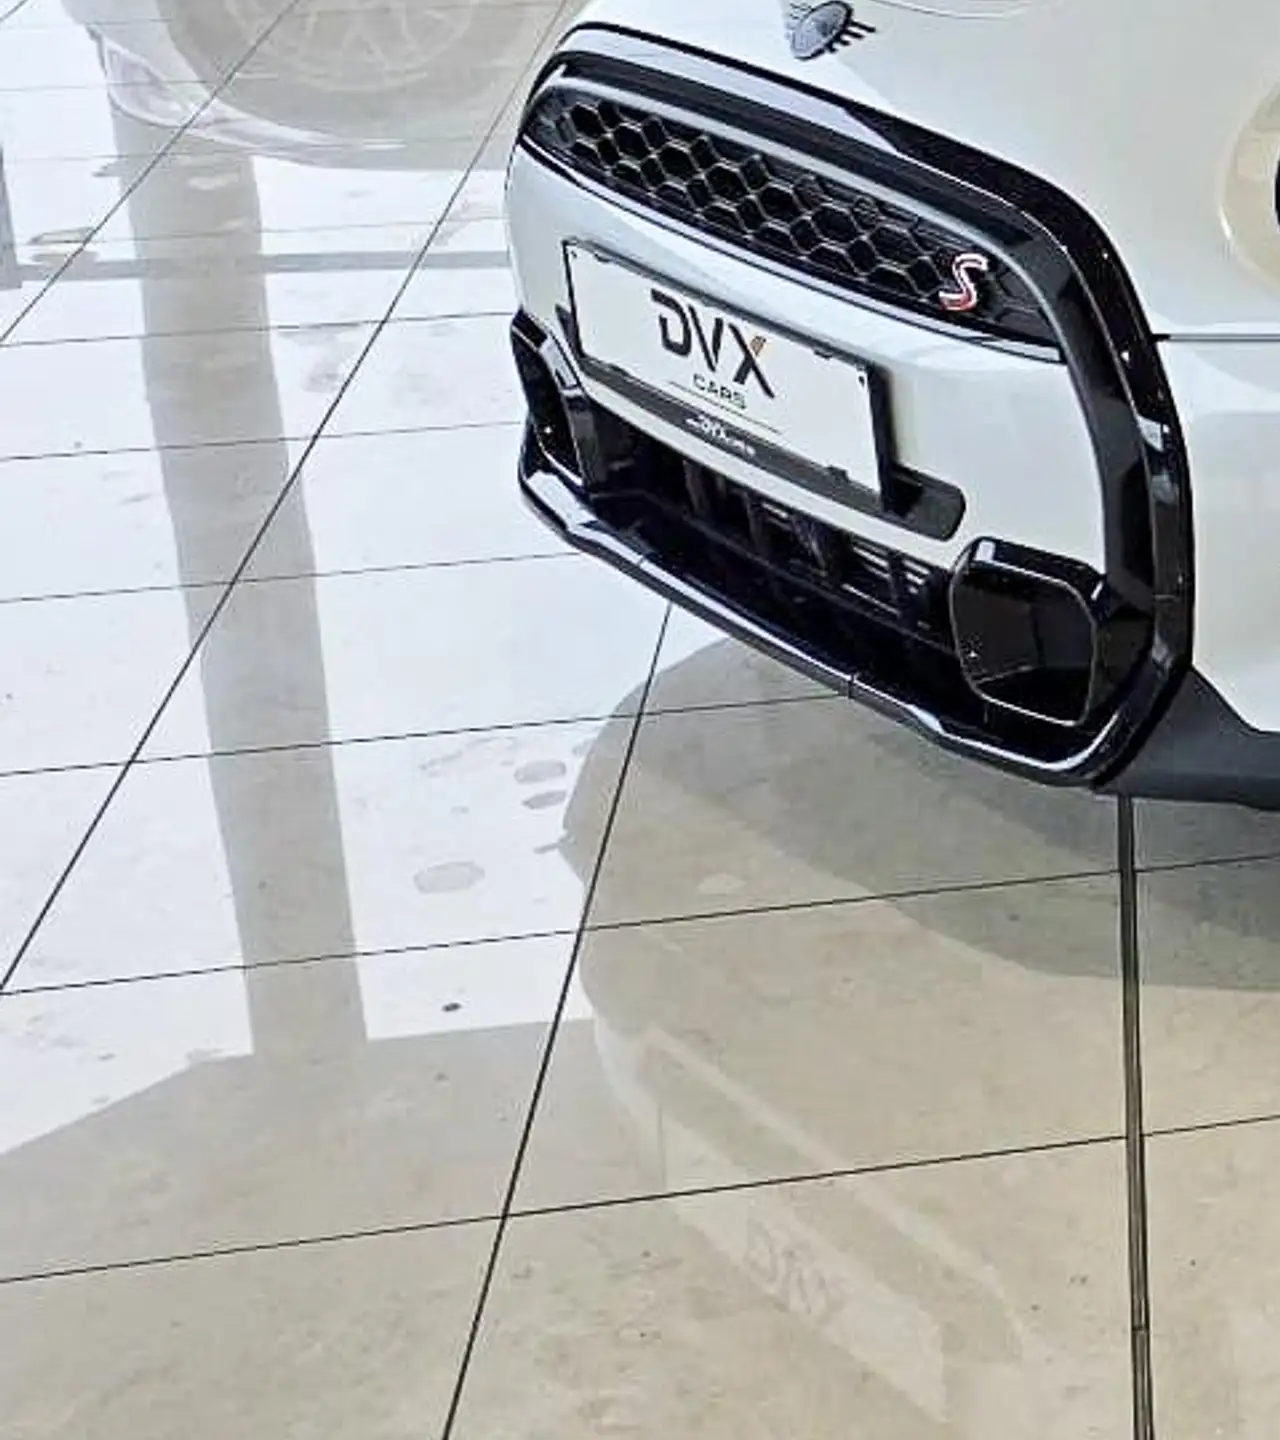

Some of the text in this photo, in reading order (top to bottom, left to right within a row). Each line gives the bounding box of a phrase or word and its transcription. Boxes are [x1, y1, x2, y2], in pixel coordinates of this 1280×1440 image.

[939, 253, 988, 311] S
[651, 287, 775, 399] DVX
[693, 373, 747, 410] CARS
